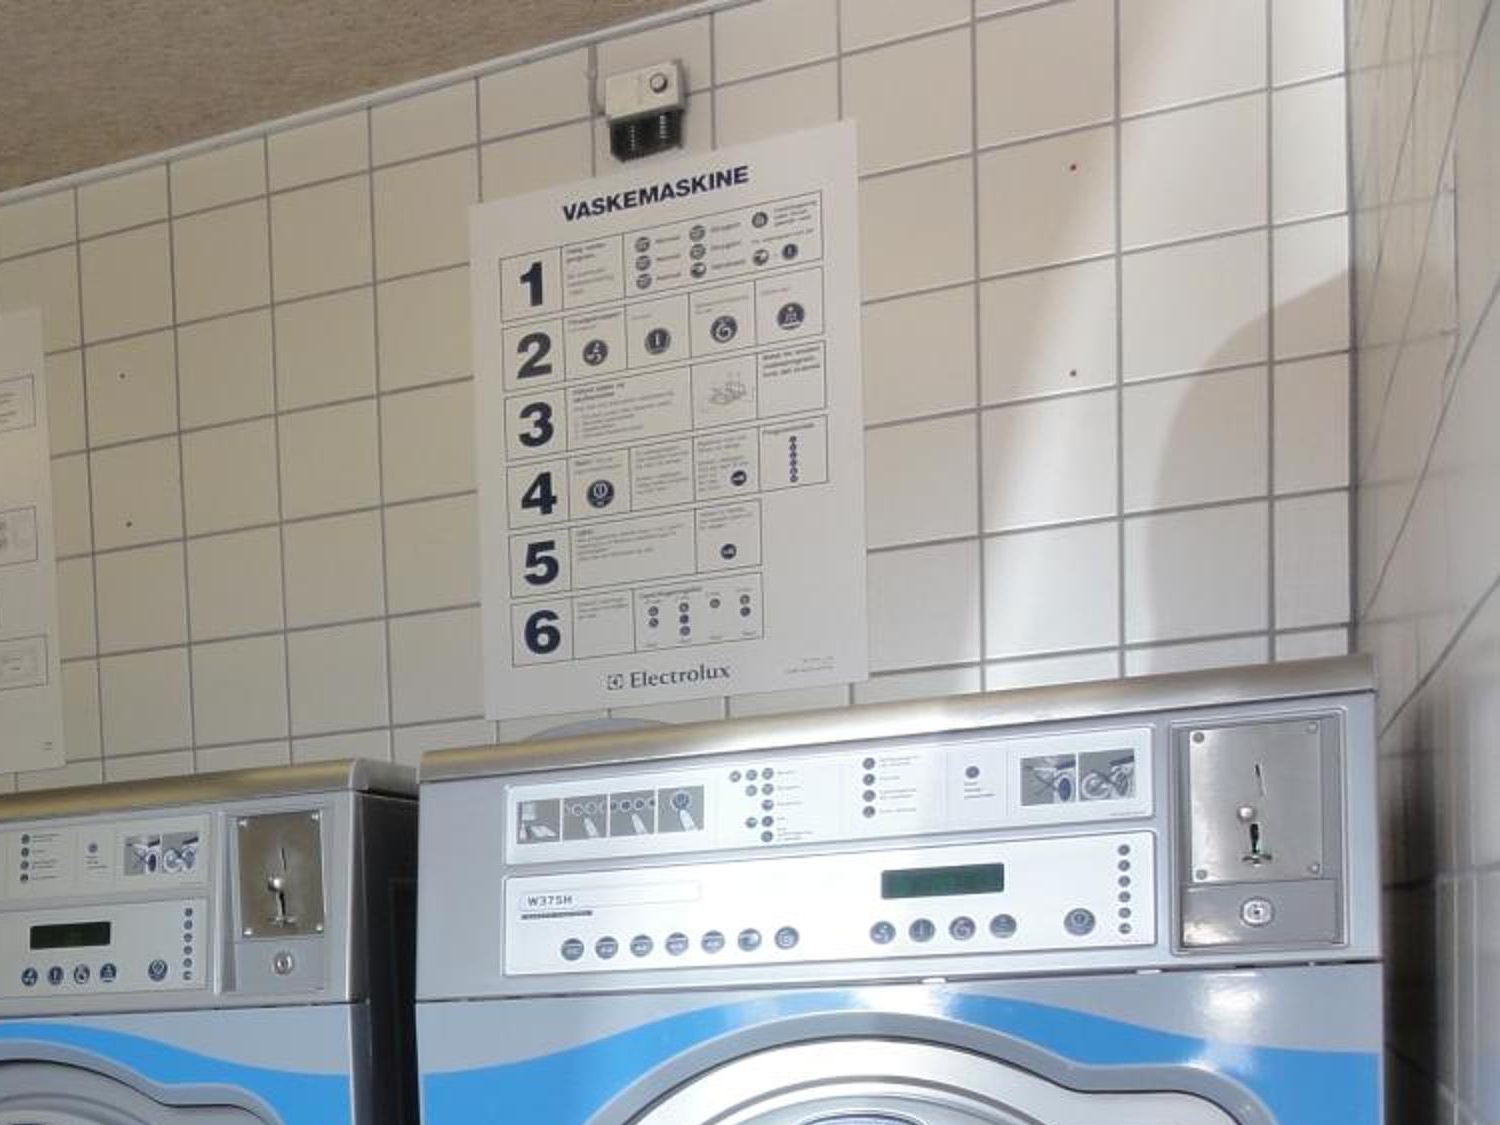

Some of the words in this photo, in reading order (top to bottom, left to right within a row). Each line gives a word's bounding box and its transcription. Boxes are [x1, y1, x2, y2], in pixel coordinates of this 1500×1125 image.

[562, 165, 750, 222] VASKEMASKINE
[519, 261, 544, 306] 1
[516, 332, 553, 379] 2
[518, 401, 555, 447] 3
[521, 471, 558, 515] 4
[523, 540, 560, 586] 5
[524, 610, 561, 654] 6
[629, 663, 731, 690] Electrolux
